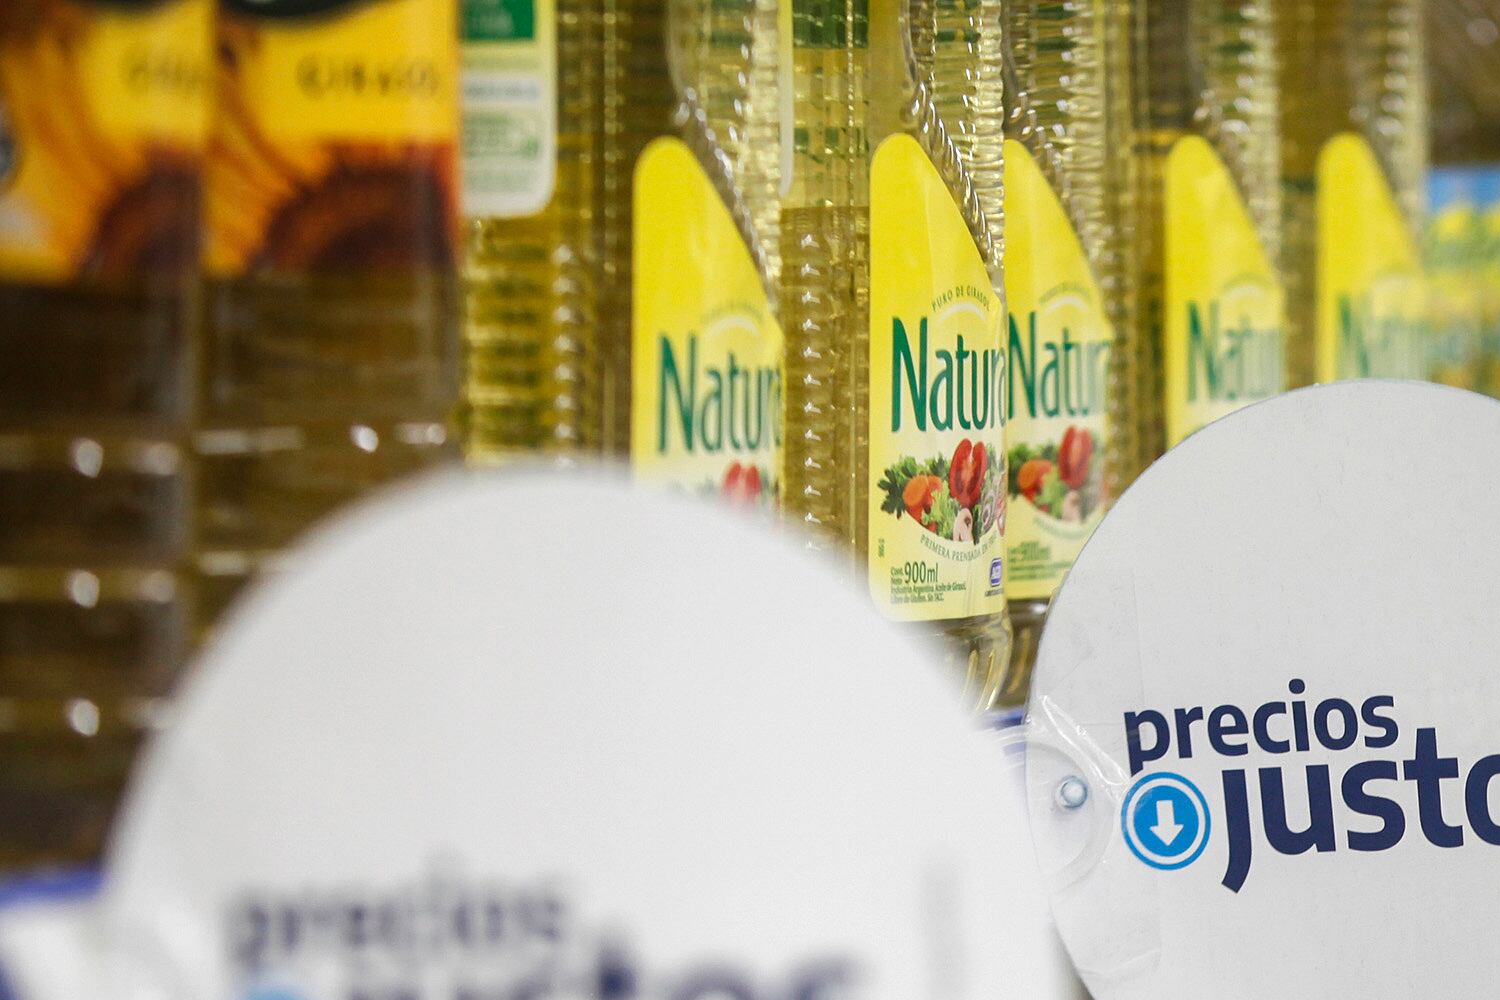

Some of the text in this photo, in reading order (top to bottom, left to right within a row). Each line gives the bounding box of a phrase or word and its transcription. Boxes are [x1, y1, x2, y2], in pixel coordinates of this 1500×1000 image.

[931, 290, 953, 312] PURO
[956, 285, 964, 297] DE
[920, 534, 950, 559] PRIMERA
[904, 561, 938, 584] 900ml
[1124, 678, 1398, 777] precios
